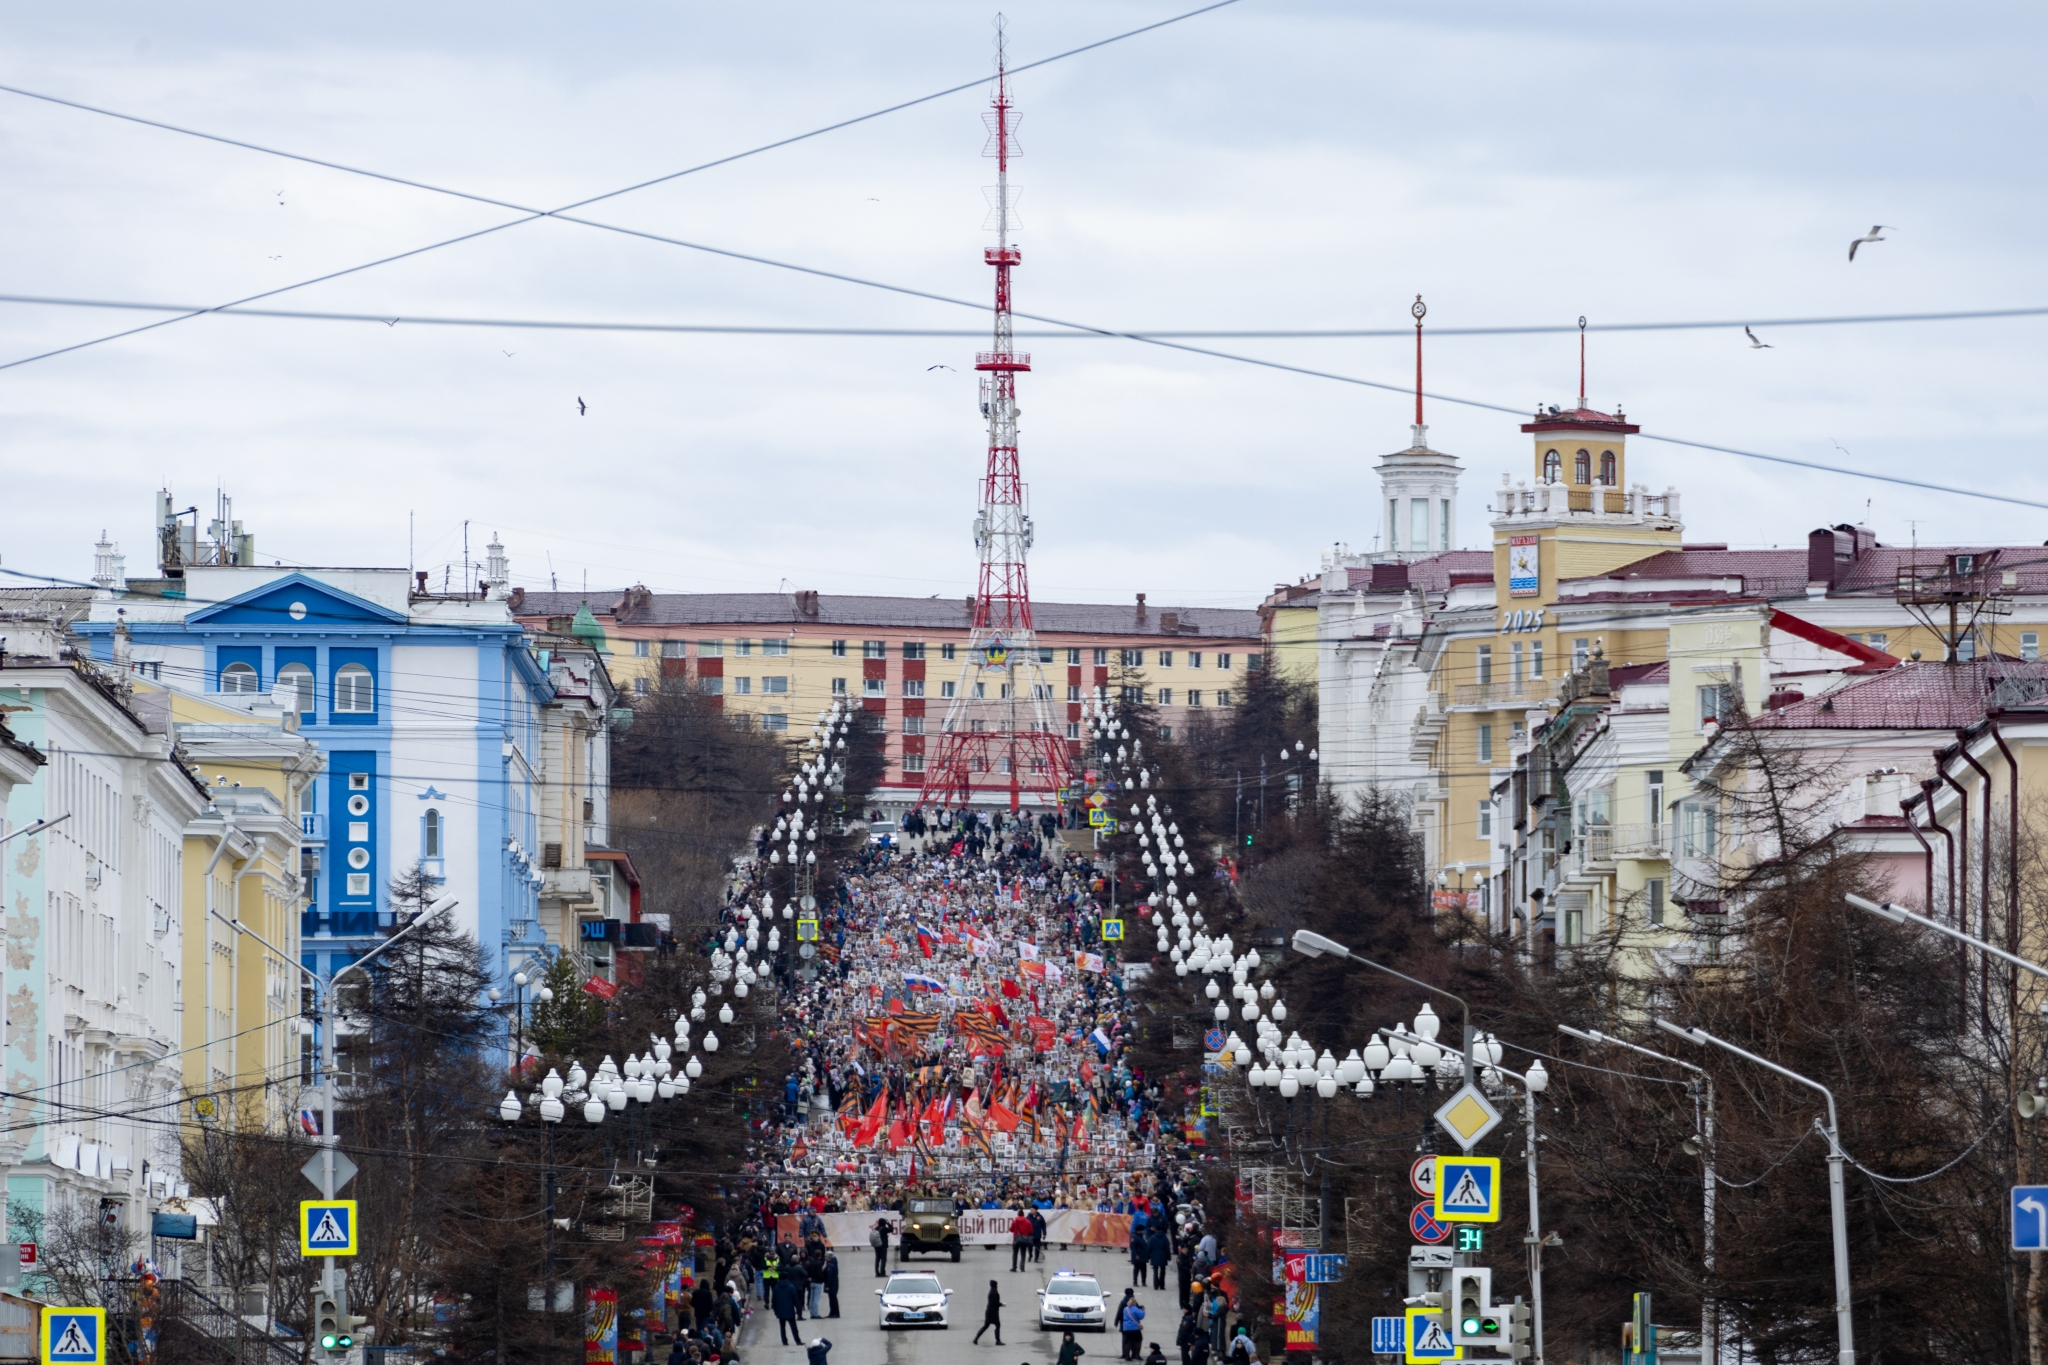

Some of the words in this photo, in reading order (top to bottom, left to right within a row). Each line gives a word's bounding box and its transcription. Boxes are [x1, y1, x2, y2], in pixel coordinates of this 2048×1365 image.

[1500, 609, 1546, 634] 2025
[1418, 1167, 1436, 1184] 4
[989, 1218, 1014, 1234] ПОЛ
[1460, 1228, 1481, 1250] 34
[1287, 1330, 1315, 1343] МАЯ
